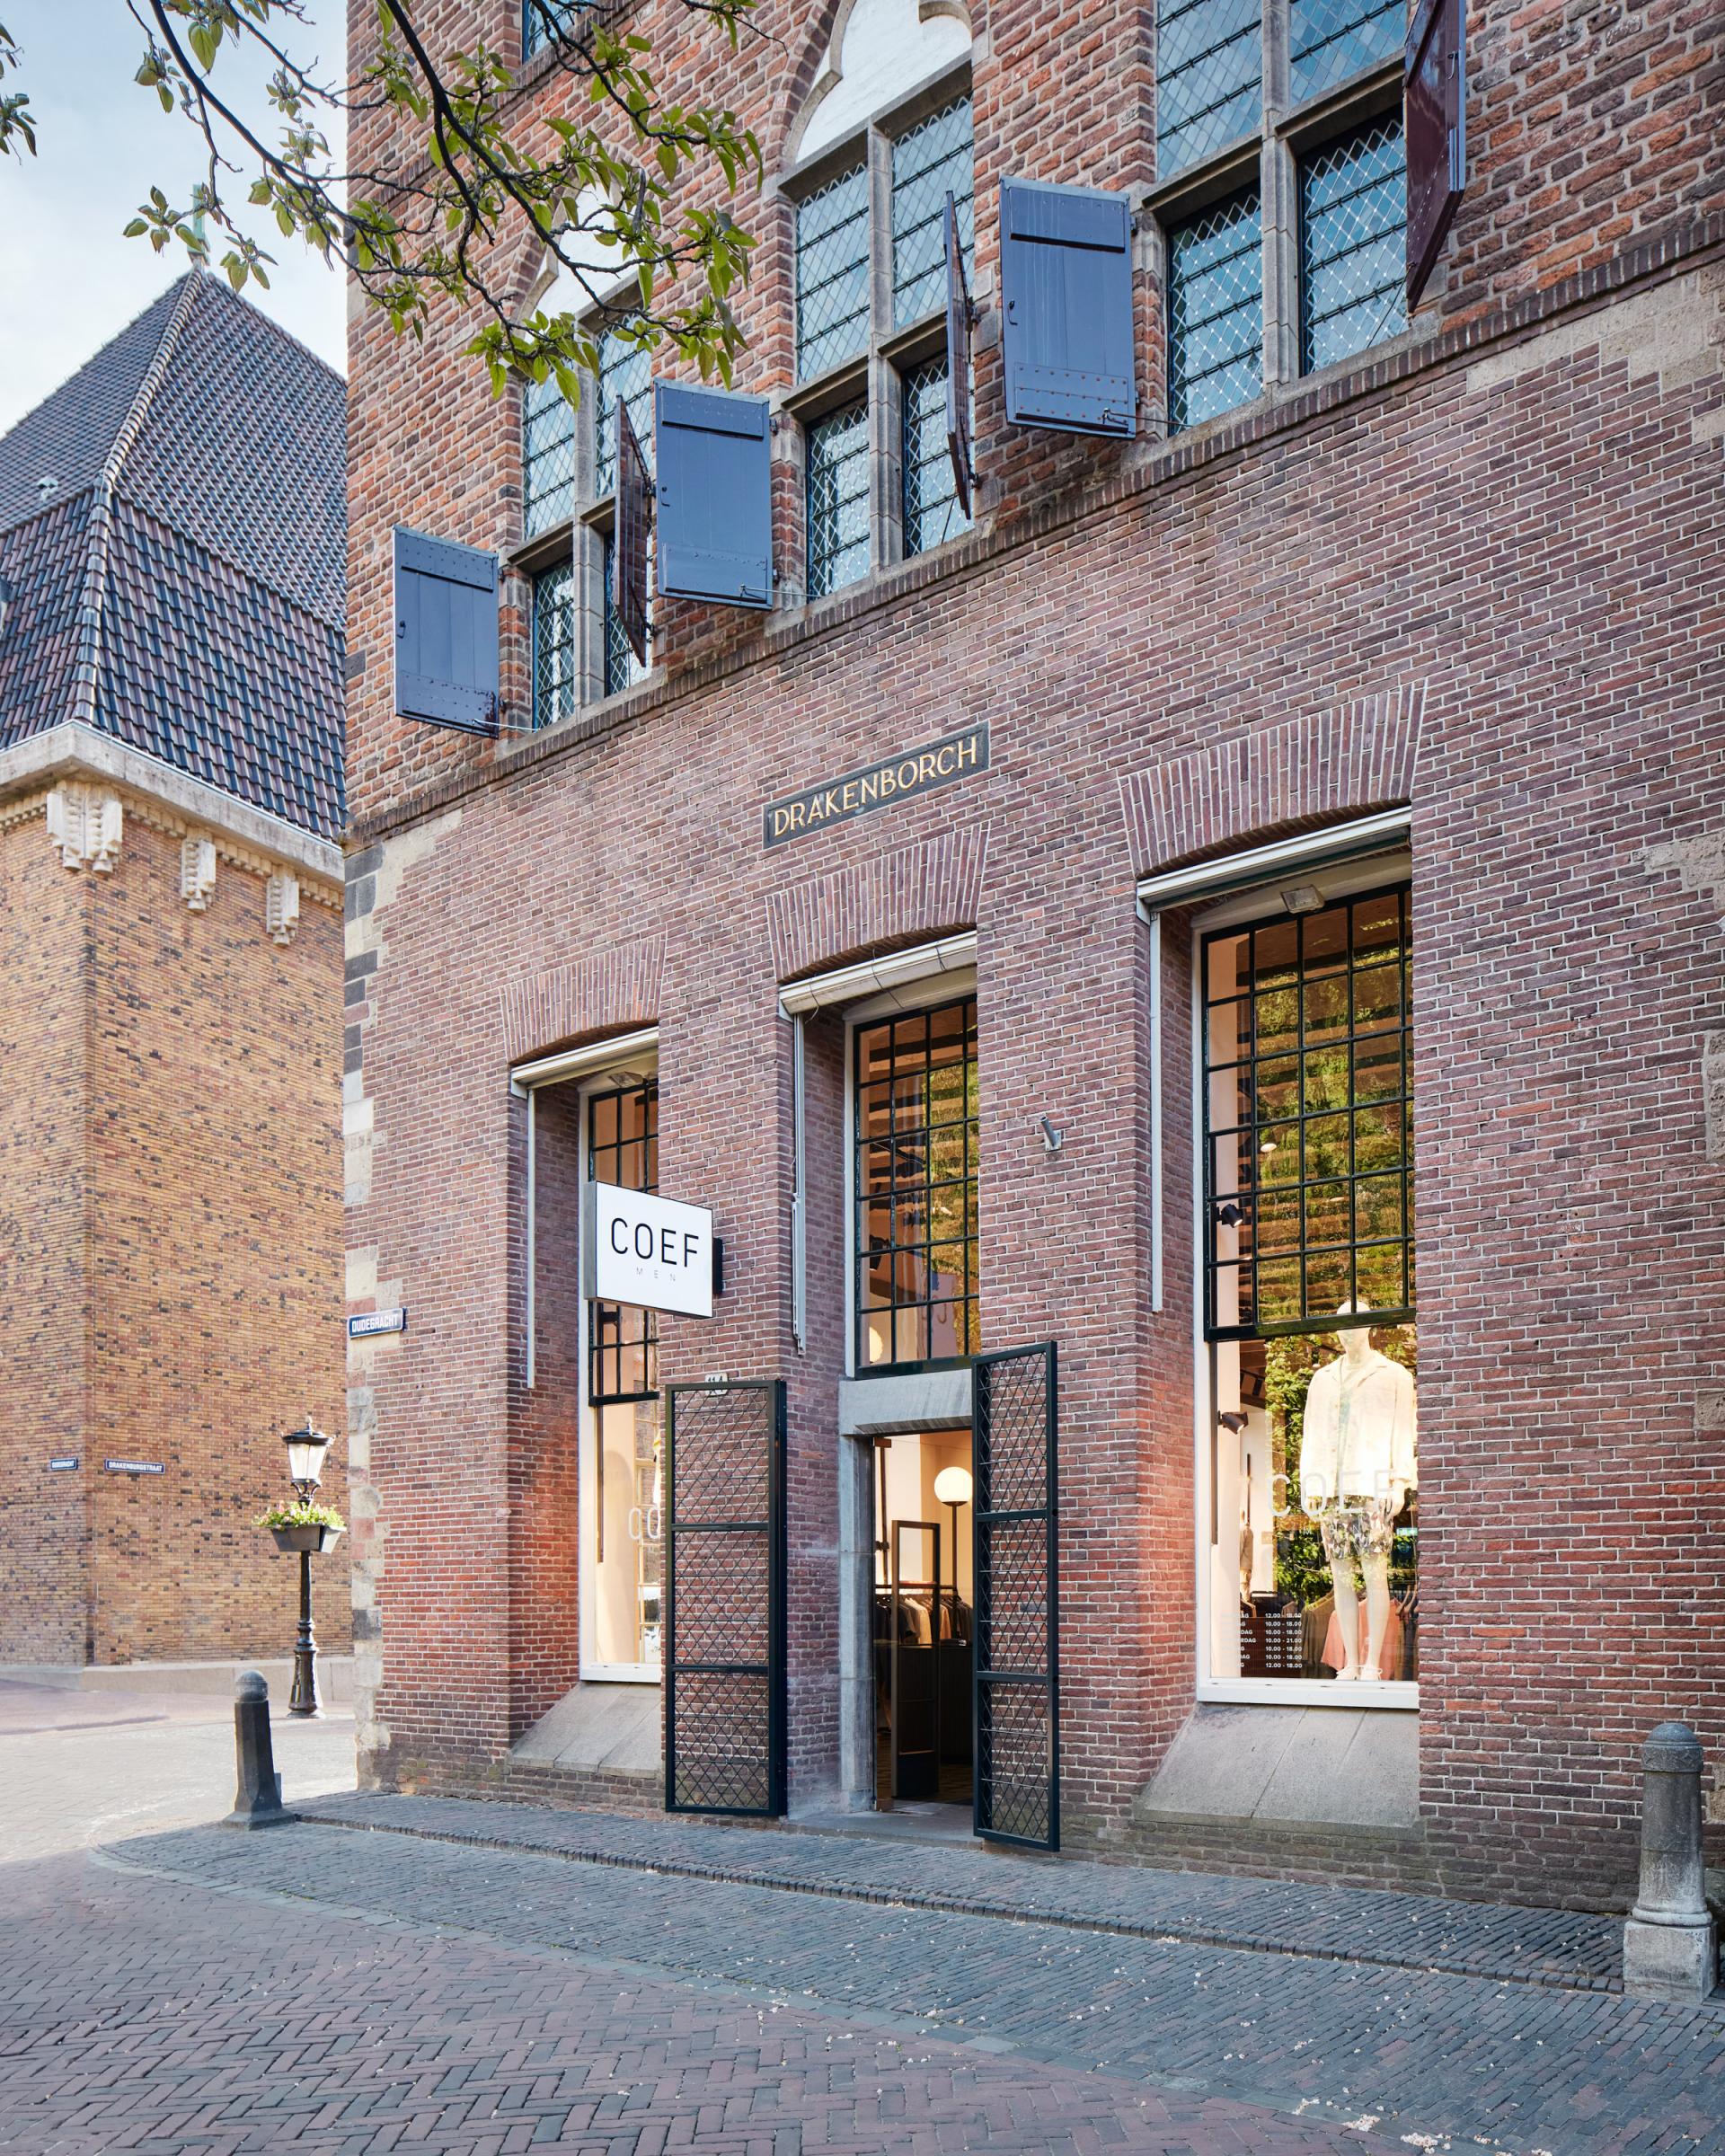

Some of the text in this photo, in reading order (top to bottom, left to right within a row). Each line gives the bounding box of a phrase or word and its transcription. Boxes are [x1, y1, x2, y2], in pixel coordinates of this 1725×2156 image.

[774, 736, 978, 836] DRAKENBORCH
[611, 1217, 699, 1268] COEF
[636, 1266, 677, 1282] MEN
[351, 1313, 398, 1332] OUDEGRACHT
[1268, 1470, 1395, 1517] COEF
